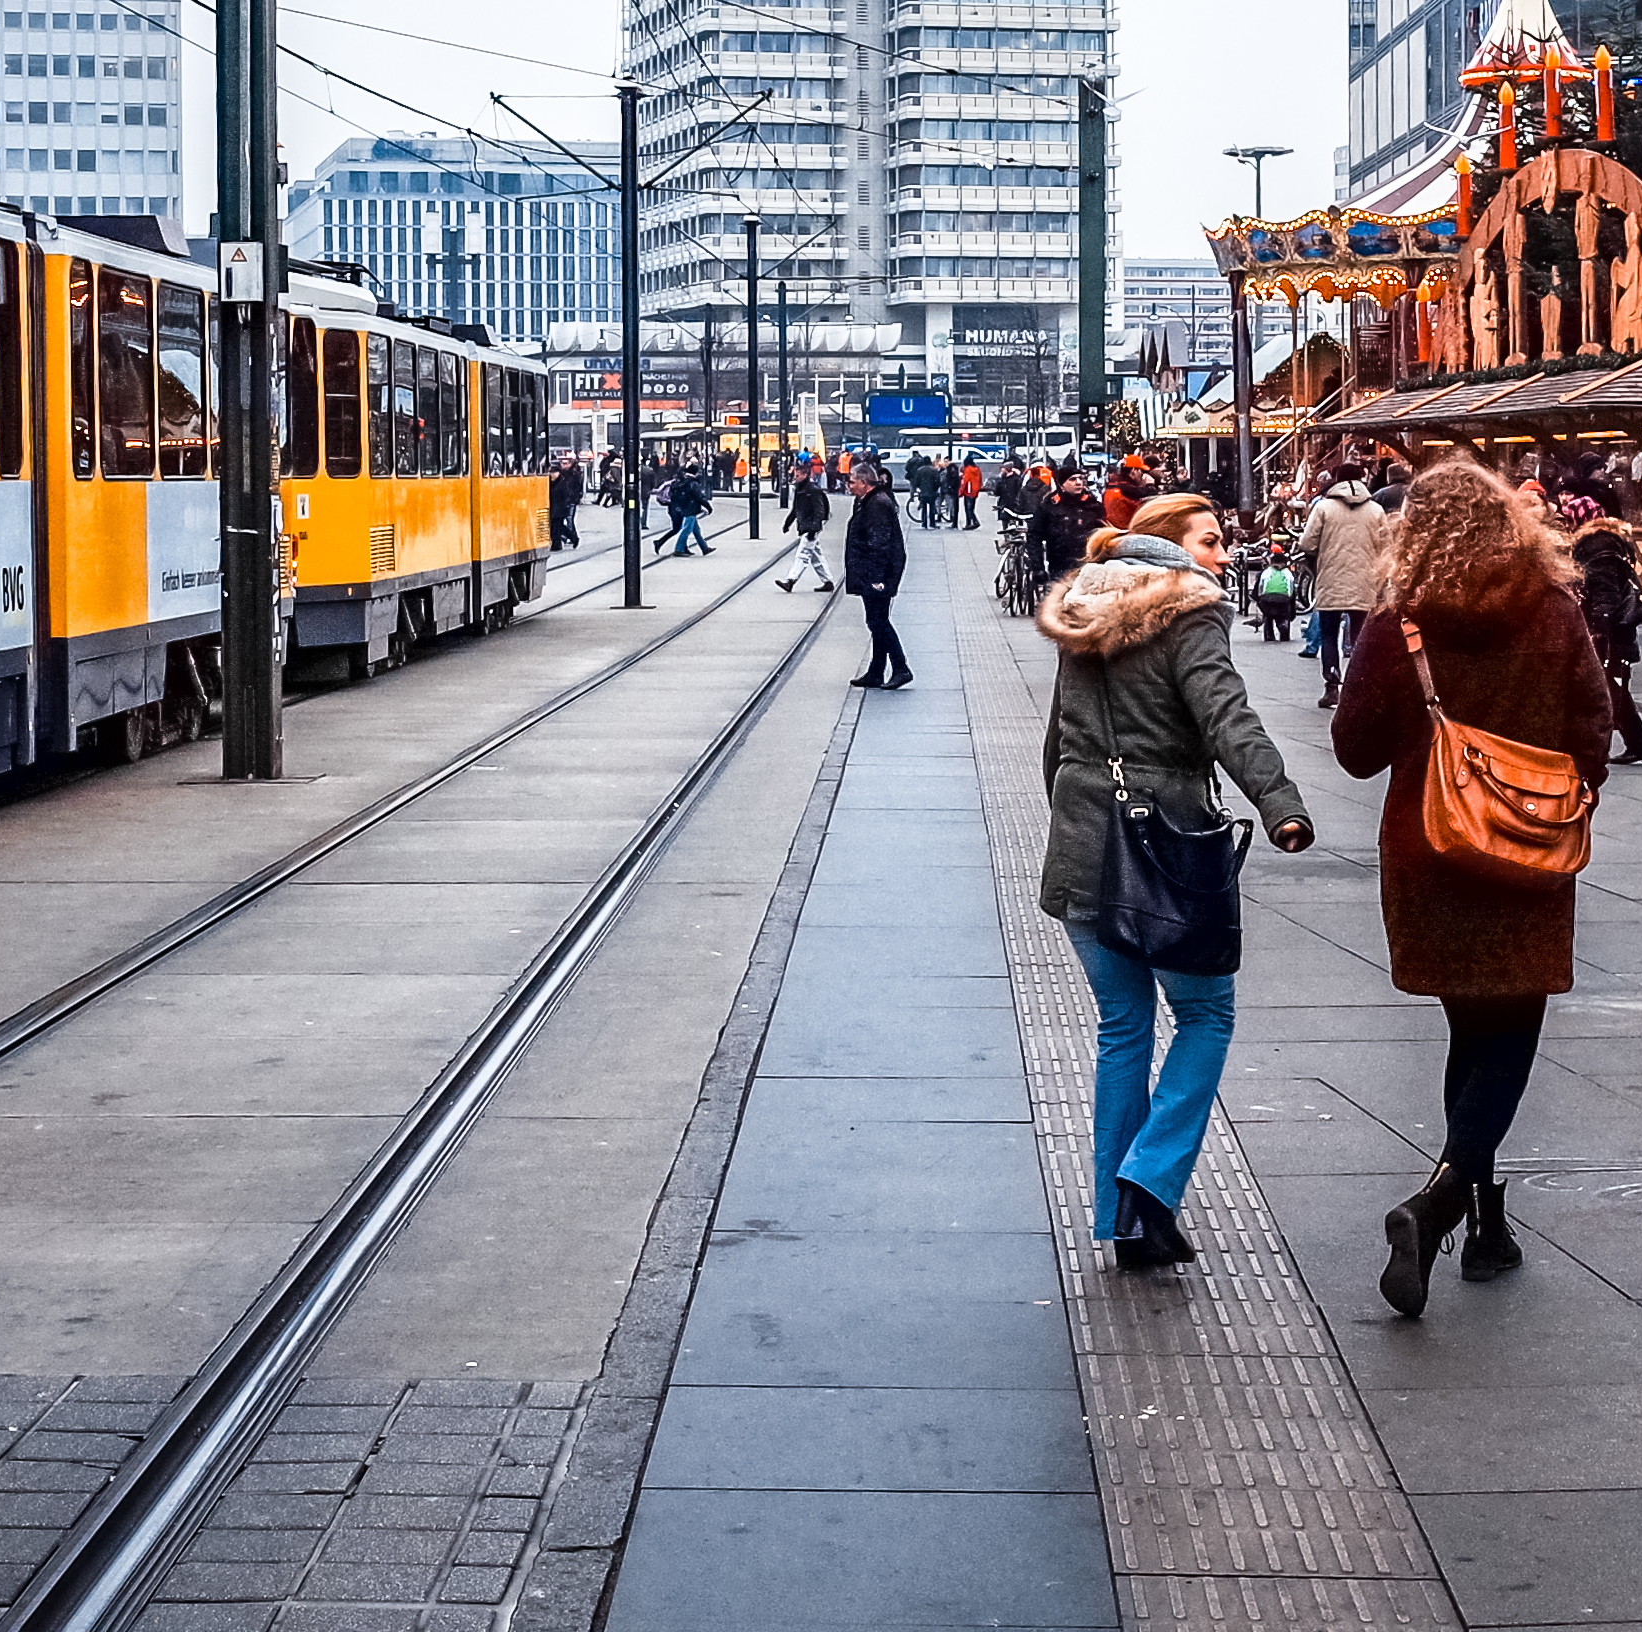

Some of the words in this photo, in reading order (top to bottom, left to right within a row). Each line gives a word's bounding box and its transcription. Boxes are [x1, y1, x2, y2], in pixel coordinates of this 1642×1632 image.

[965, 329, 1049, 343] HUMANA
[902, 398, 913, 413] U
[2, 565, 25, 613] BVG
